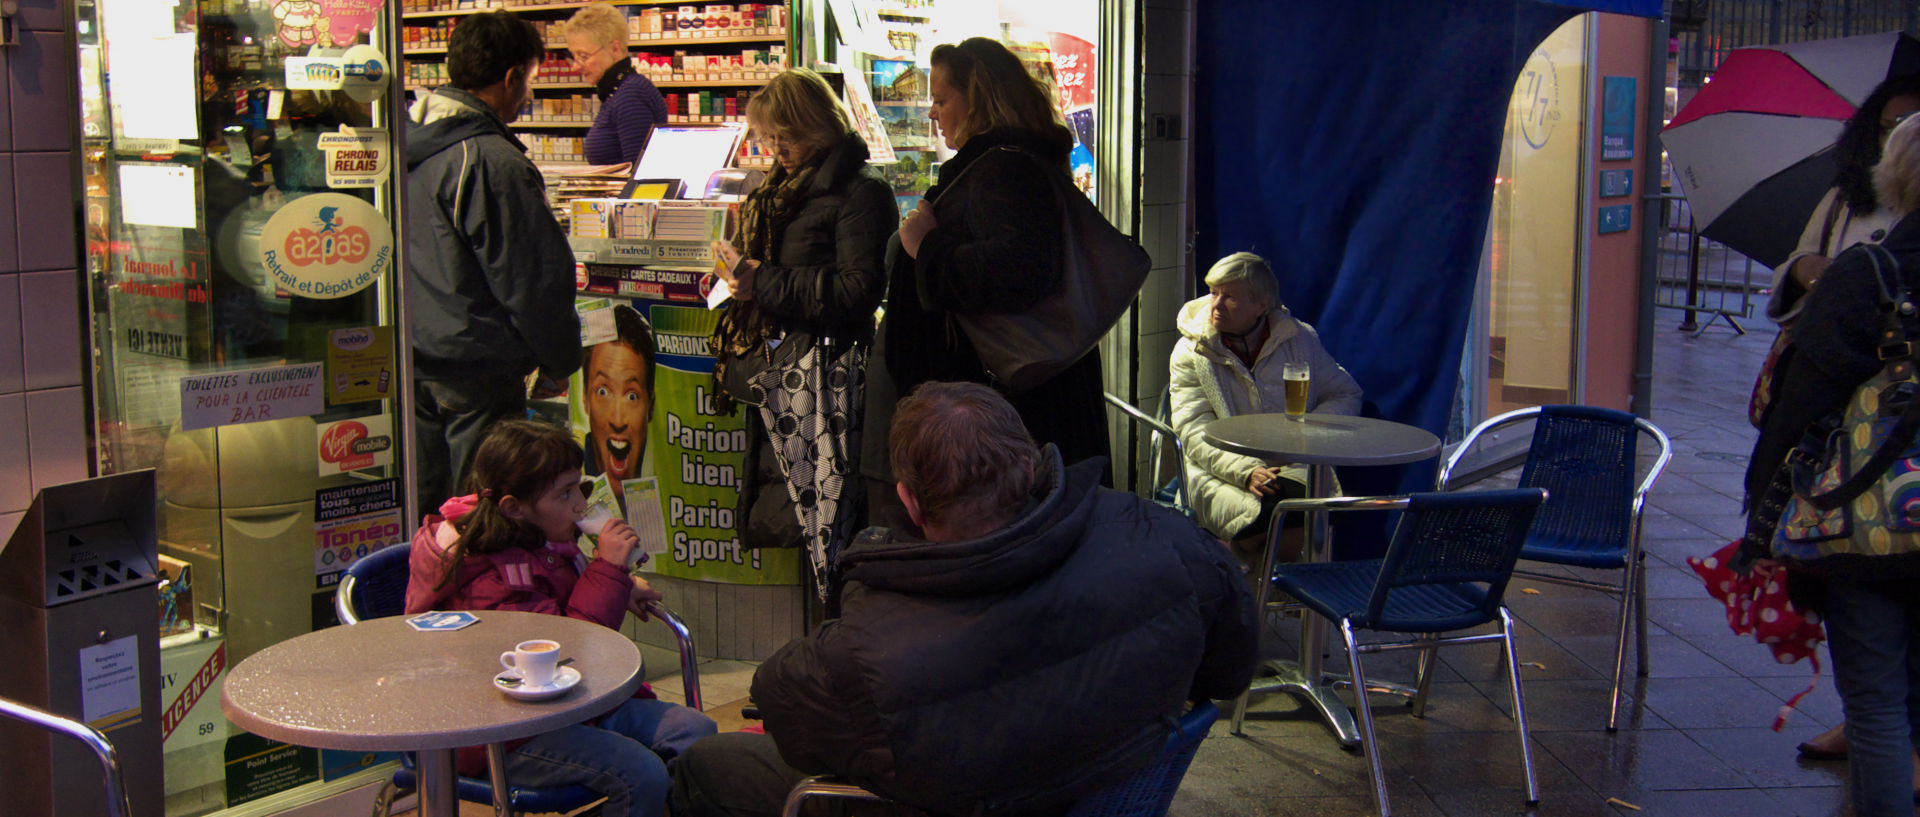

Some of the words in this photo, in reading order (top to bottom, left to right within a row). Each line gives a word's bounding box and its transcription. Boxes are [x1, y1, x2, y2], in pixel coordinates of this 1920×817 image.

[336, 150, 378, 159] CHRONO
[335, 160, 377, 171] RELAIS
[613, 245, 650, 255] Vendredi
[658, 246, 664, 257] 5
[264, 249, 297, 288] Retrait
[298, 281, 312, 293] et
[315, 279, 353, 296] Dépôt
[355, 272, 370, 285] de
[371, 245, 390, 273] colis
[631, 269, 656, 282] CARTES
[657, 271, 691, 285] CADEAUX
[186, 375, 238, 392] TOILETTES
[249, 365, 321, 385] EXCLUSIVEMENT
[196, 392, 230, 410] POUR
[236, 391, 249, 405] LA
[256, 383, 314, 402] CLIENTELE
[231, 404, 271, 423] BAR
[325, 424, 360, 459] Virgin
[667, 412, 746, 453] Parion
[356, 438, 387, 453] mobile
[681, 453, 743, 492] bien,
[320, 482, 391, 500] maintenant
[320, 498, 350, 509] tous
[320, 504, 357, 519] moins
[316, 521, 400, 549] Tonéo
[673, 531, 742, 567] Sport
[321, 573, 339, 585] EN
[161, 672, 178, 689] IV
[161, 654, 218, 740] LICENCE
[198, 722, 214, 736] 59
[247, 756, 268, 769] Point
[269, 749, 298, 763] Service
